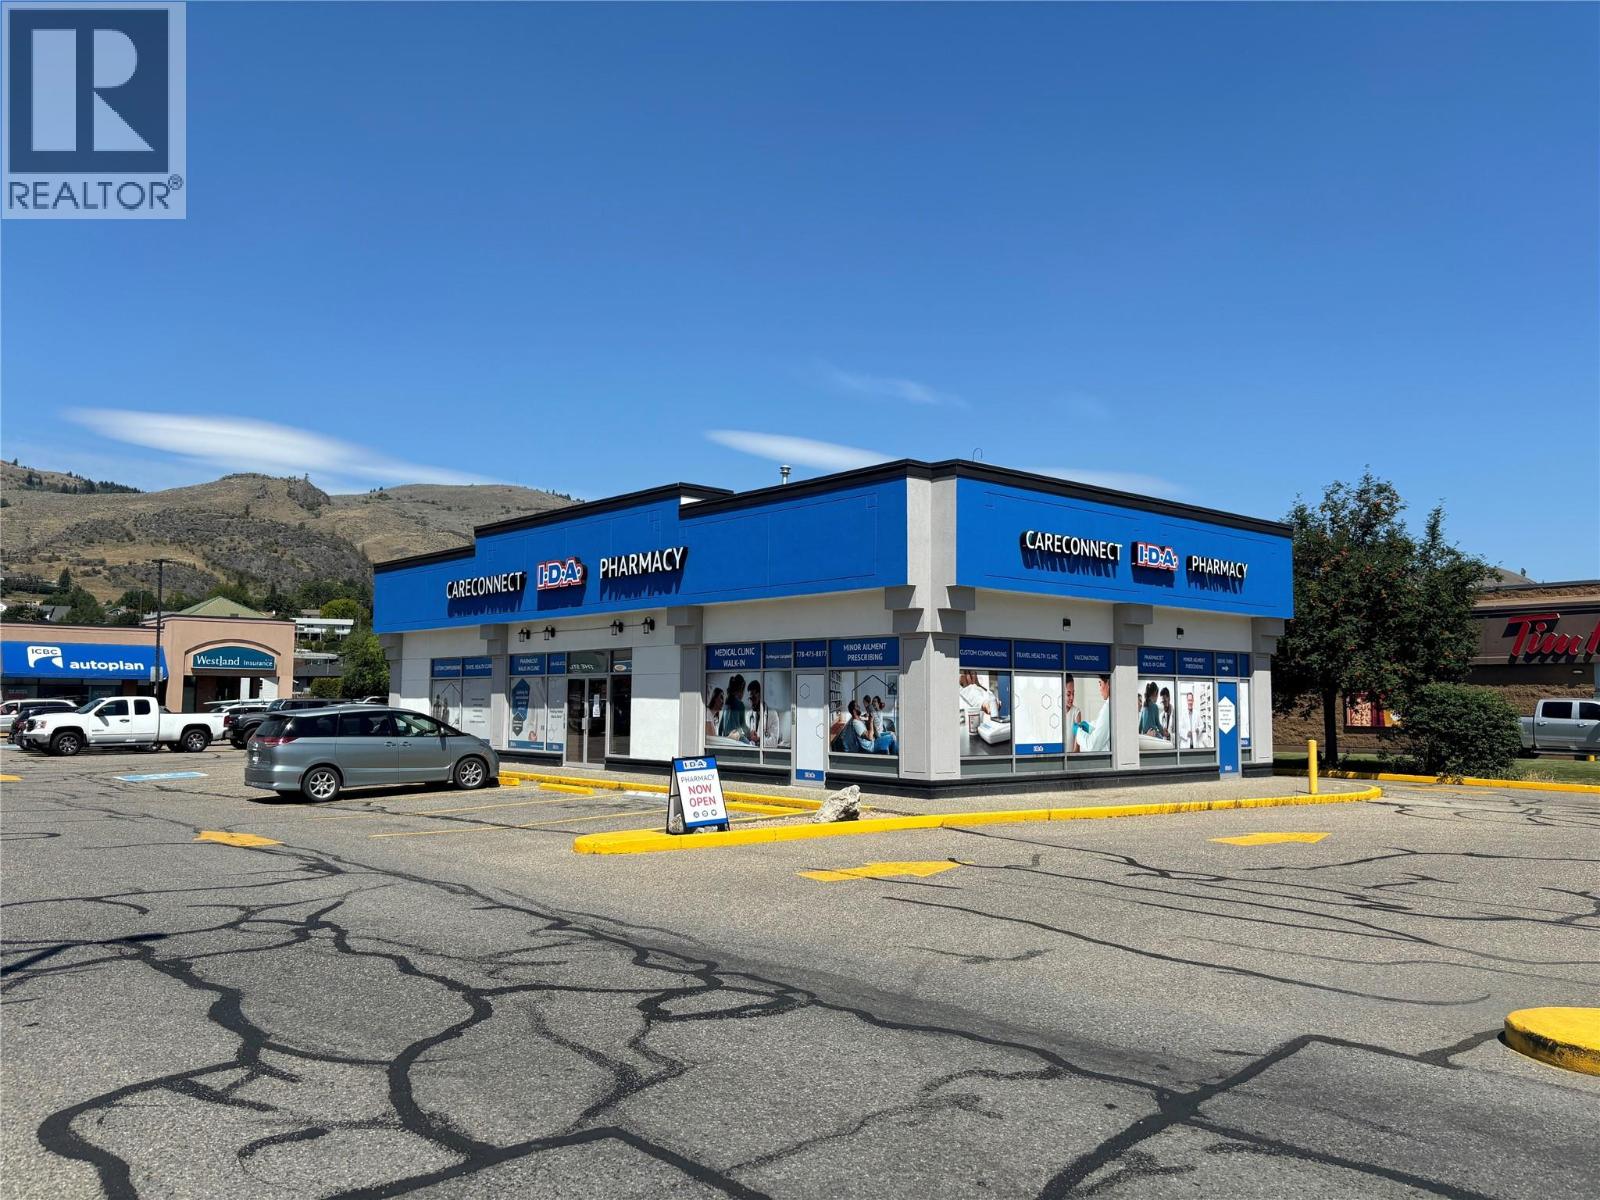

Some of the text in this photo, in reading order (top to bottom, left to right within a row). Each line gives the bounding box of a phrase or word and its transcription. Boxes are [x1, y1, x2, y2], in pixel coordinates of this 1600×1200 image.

[1025, 530, 1123, 561] CARECONNECT
[1191, 555, 1248, 578] PHARMACY
[446, 572, 523, 599] CARECONNECT
[599, 546, 684, 579] PHARMACY
[1507, 611, 1584, 656] Tim
[715, 647, 755, 657] MEDICAL CLINIC
[843, 642, 887, 651] MINOR AILMENT
[196, 655, 240, 666] Westland
[847, 653, 883, 661] PRESCRIBING
[69, 660, 145, 671] autoplan
[723, 659, 746, 667] WALK-IN
[681, 774, 715, 783] PHARMACY
[688, 783, 712, 795] NOW
[689, 796, 717, 807] OPEN
